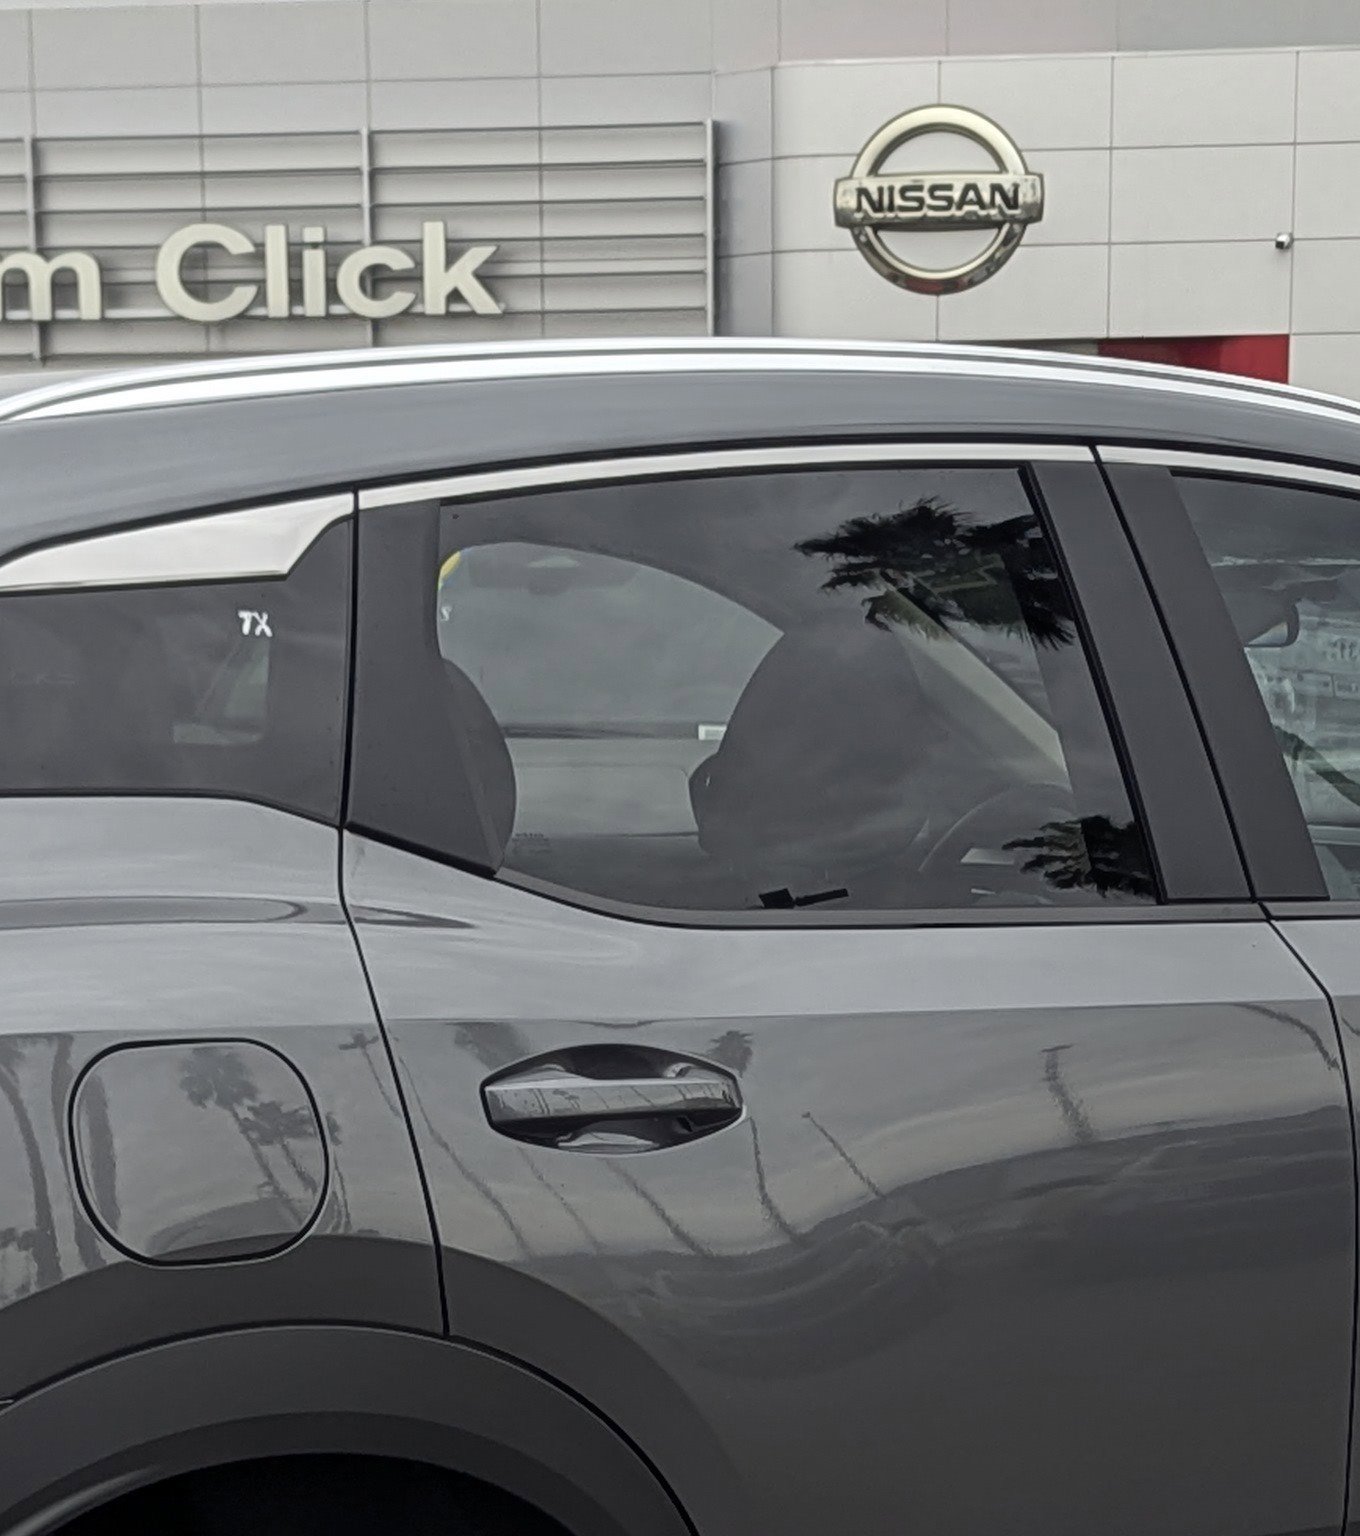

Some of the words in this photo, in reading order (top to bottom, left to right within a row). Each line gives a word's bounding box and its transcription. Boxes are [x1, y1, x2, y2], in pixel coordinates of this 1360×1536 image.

[854, 182, 1020, 213] NISSAN
[156, 221, 504, 322] Click
[237, 609, 274, 638] TX
